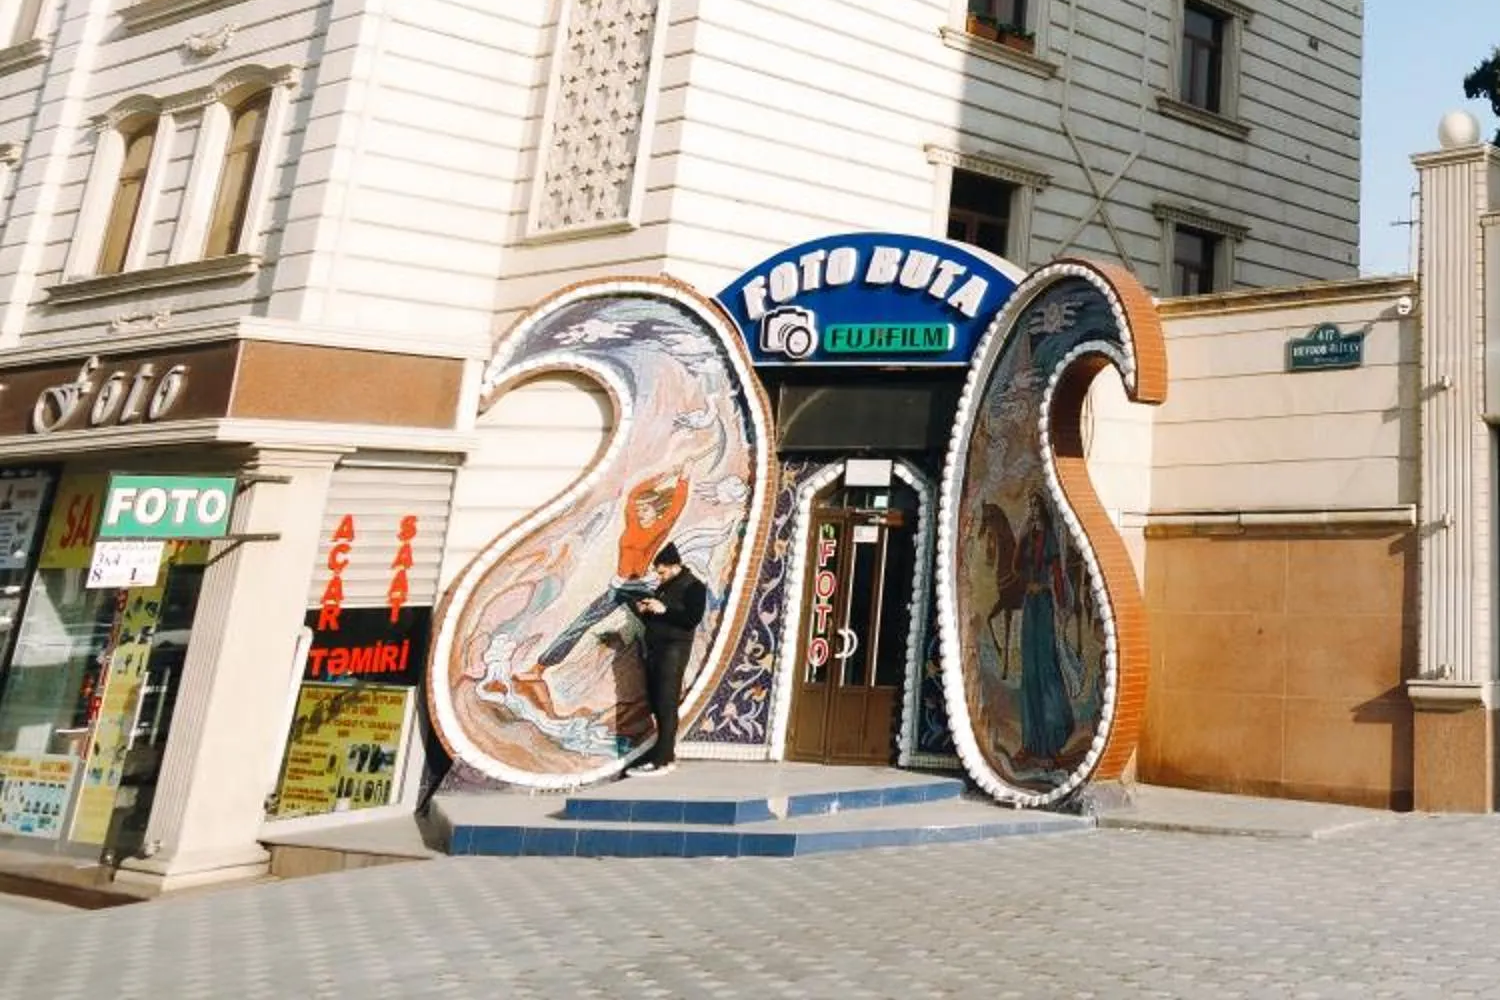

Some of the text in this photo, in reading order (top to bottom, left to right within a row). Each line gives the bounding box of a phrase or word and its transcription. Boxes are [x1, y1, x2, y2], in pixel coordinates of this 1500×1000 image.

[743, 245, 989, 320] FOTO BUTA
[831, 327, 943, 348] FUJIFILM
[107, 486, 228, 526] FOTO
[388, 515, 417, 624] SAAT
[807, 539, 837, 666] FOTO
